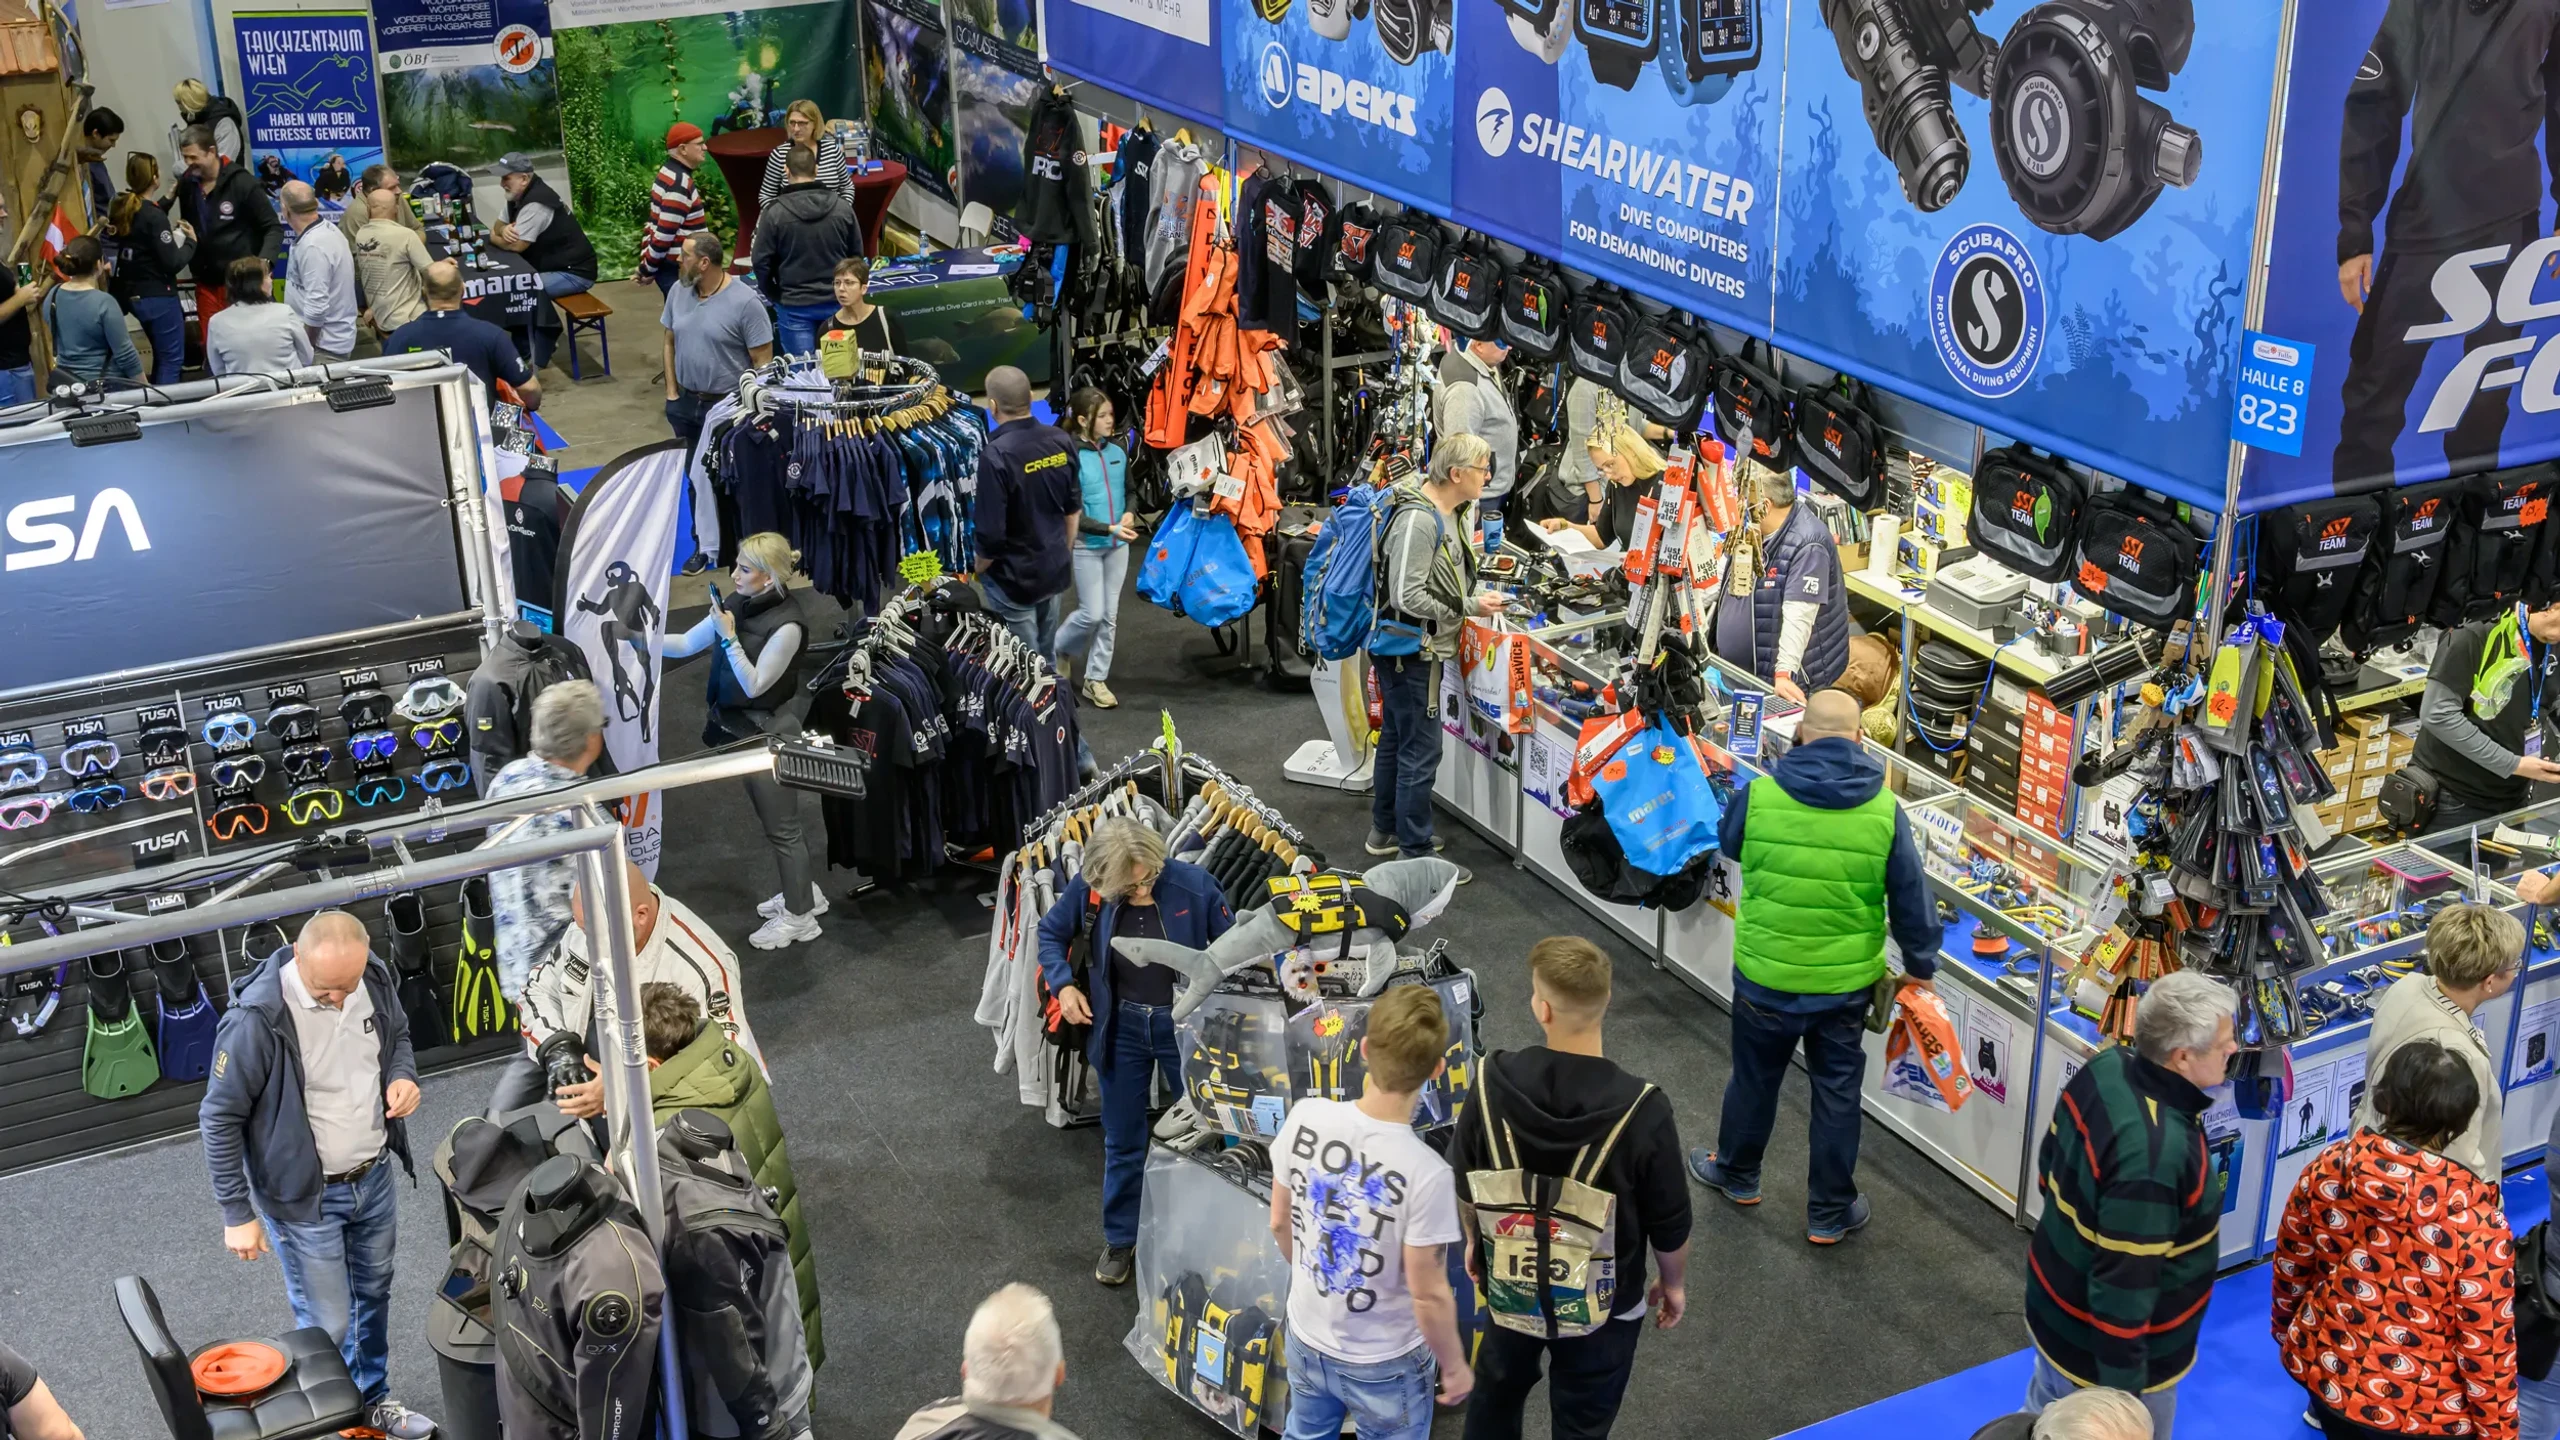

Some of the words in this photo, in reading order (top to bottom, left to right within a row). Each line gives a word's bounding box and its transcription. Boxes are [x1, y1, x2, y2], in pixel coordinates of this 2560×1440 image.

[393, 14, 442, 25] VORDERER
[443, 11, 492, 22] GOSAUSEE
[1157, 3, 1182, 19] MEHR
[381, 23, 428, 36] VORDERER
[429, 20, 493, 32] LANGBATHSEE
[242, 29, 364, 53] TAUCHZENTRUM
[247, 54, 287, 75] WIEN
[404, 54, 431, 66] ÖBf
[1296, 62, 1417, 138] apeks
[2024, 81, 2064, 110] SCUBAPRO
[269, 113, 304, 126] HABEN
[307, 112, 328, 126] WIR
[331, 112, 355, 125] DEIN
[257, 128, 312, 142] INTERESSE
[315, 126, 371, 140] GEWECKT?
[1518, 113, 1755, 226] SHEARWATER
[1620, 203, 1653, 231] DIVE
[1656, 216, 1748, 263] COMPUTERS
[1396, 256, 1412, 270] TEAM
[1570, 220, 1597, 245] FOR
[1600, 230, 1687, 278] DEMANDING
[1690, 264, 1746, 299] DIVERS
[1948, 232, 2034, 288] SCUBAPRO
[463, 272, 544, 298] mares
[866, 273, 939, 288] ARD
[510, 292, 528, 303] just
[1454, 285, 1469, 301] TEAM
[505, 303, 532, 314] water
[522, 297, 538, 307] add
[900, 307, 934, 316] kontrolliert
[935, 305, 946, 313] die
[946, 303, 961, 311] Dive
[961, 301, 977, 310] Card
[1523, 307, 1540, 322] TEAM
[1593, 335, 1607, 350] TEAM
[1936, 294, 1972, 378] PROFESSIONAL
[1972, 371, 2004, 387] DIVING
[2006, 325, 2038, 382] EQUIPMENT
[1649, 362, 1668, 382] TEAM
[2241, 366, 2288, 393] HALLE
[2292, 379, 2305, 396] 8
[2238, 394, 2298, 435] 823
[1824, 438, 1842, 460] TEAM
[1024, 452, 1068, 474] CRESSI
[1660, 498, 1678, 509] just
[2503, 496, 2528, 510] TEAM
[2011, 507, 2033, 528] TEAM
[2411, 516, 2433, 532] TEAM
[6, 487, 151, 572] SA
[1663, 545, 1681, 554] just
[2319, 537, 2346, 551] TEAM
[1697, 560, 1714, 572] just
[2118, 554, 2141, 575] TEAM
[1802, 576, 1820, 592] 75
[408, 659, 444, 674] TUSA
[1512, 641, 1527, 689] SERVICE
[342, 671, 379, 687] TUSA
[268, 684, 305, 699] TUSA
[205, 697, 243, 711] TUSA
[139, 707, 178, 722] TUSA
[65, 721, 104, 736] TUSA
[1628, 789, 1675, 823] mares
[137, 831, 190, 854] TUSA
[150, 893, 183, 907] TUSA
[19, 980, 43, 991] TUSA
[482, 1005, 490, 1023] TUSA
[1292, 1125, 1407, 1206] BOYS
